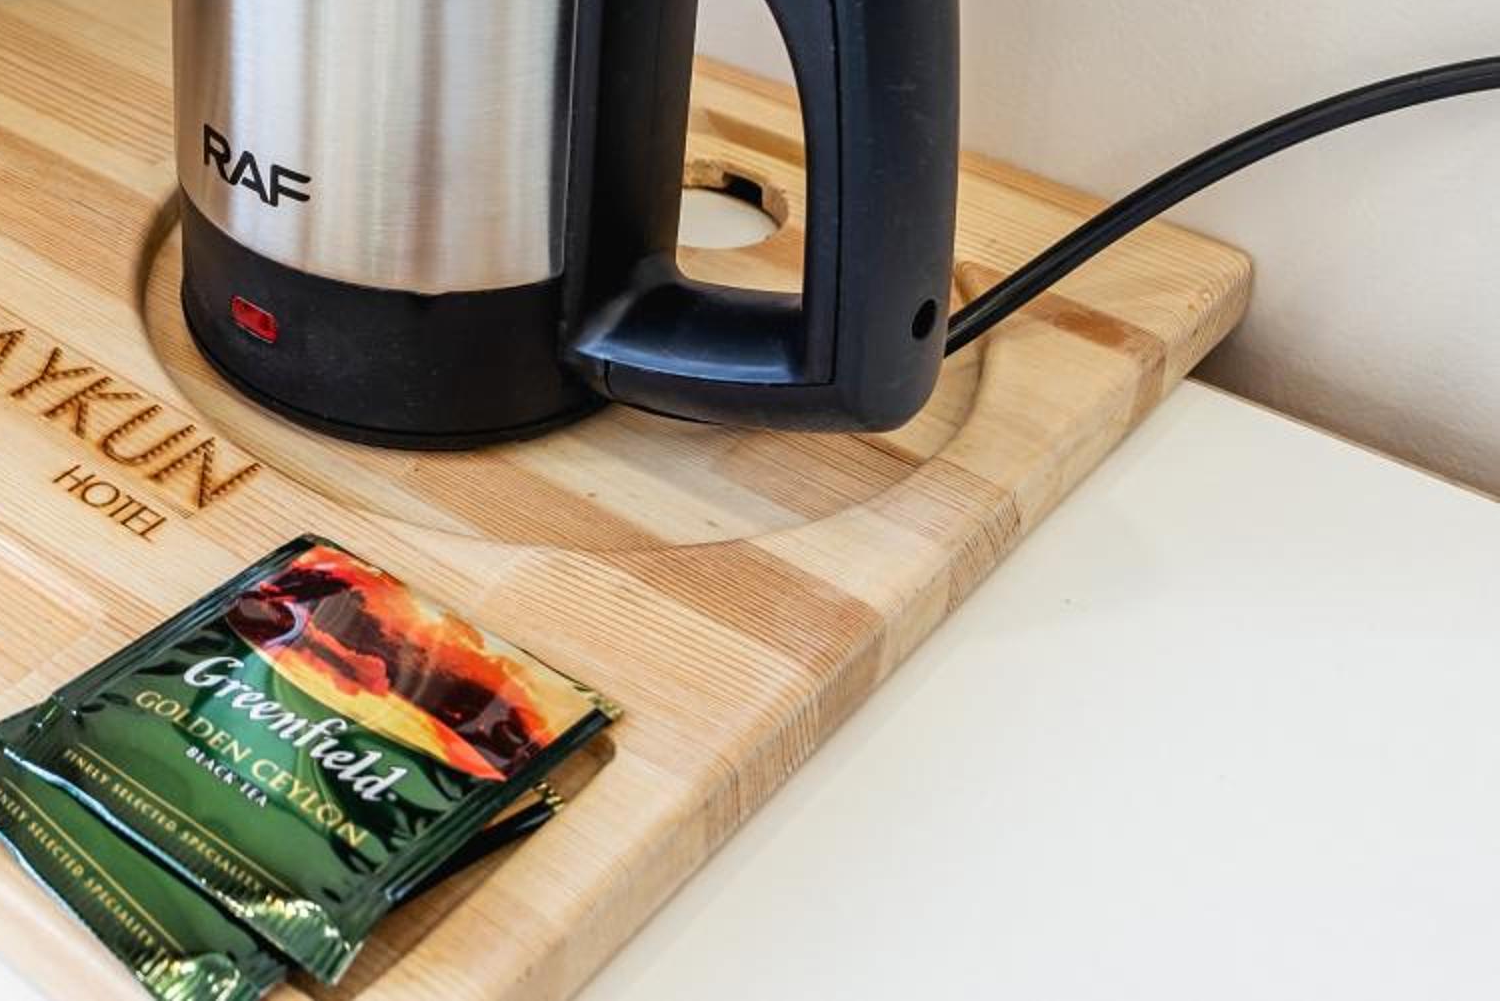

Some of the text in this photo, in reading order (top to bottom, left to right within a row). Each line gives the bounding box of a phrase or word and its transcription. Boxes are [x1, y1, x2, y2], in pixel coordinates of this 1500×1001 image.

[203, 123, 311, 207] RAF
[52, 464, 167, 542] HOTEL
[135, 690, 368, 847] GOLDEN CEYLON
[183, 656, 407, 802] Greenfield
[64, 748, 112, 784] FINELY
[111, 782, 178, 833] SELECTED
[185, 745, 268, 808] BLACK TEA
[27, 821, 85, 877] SELECTED
